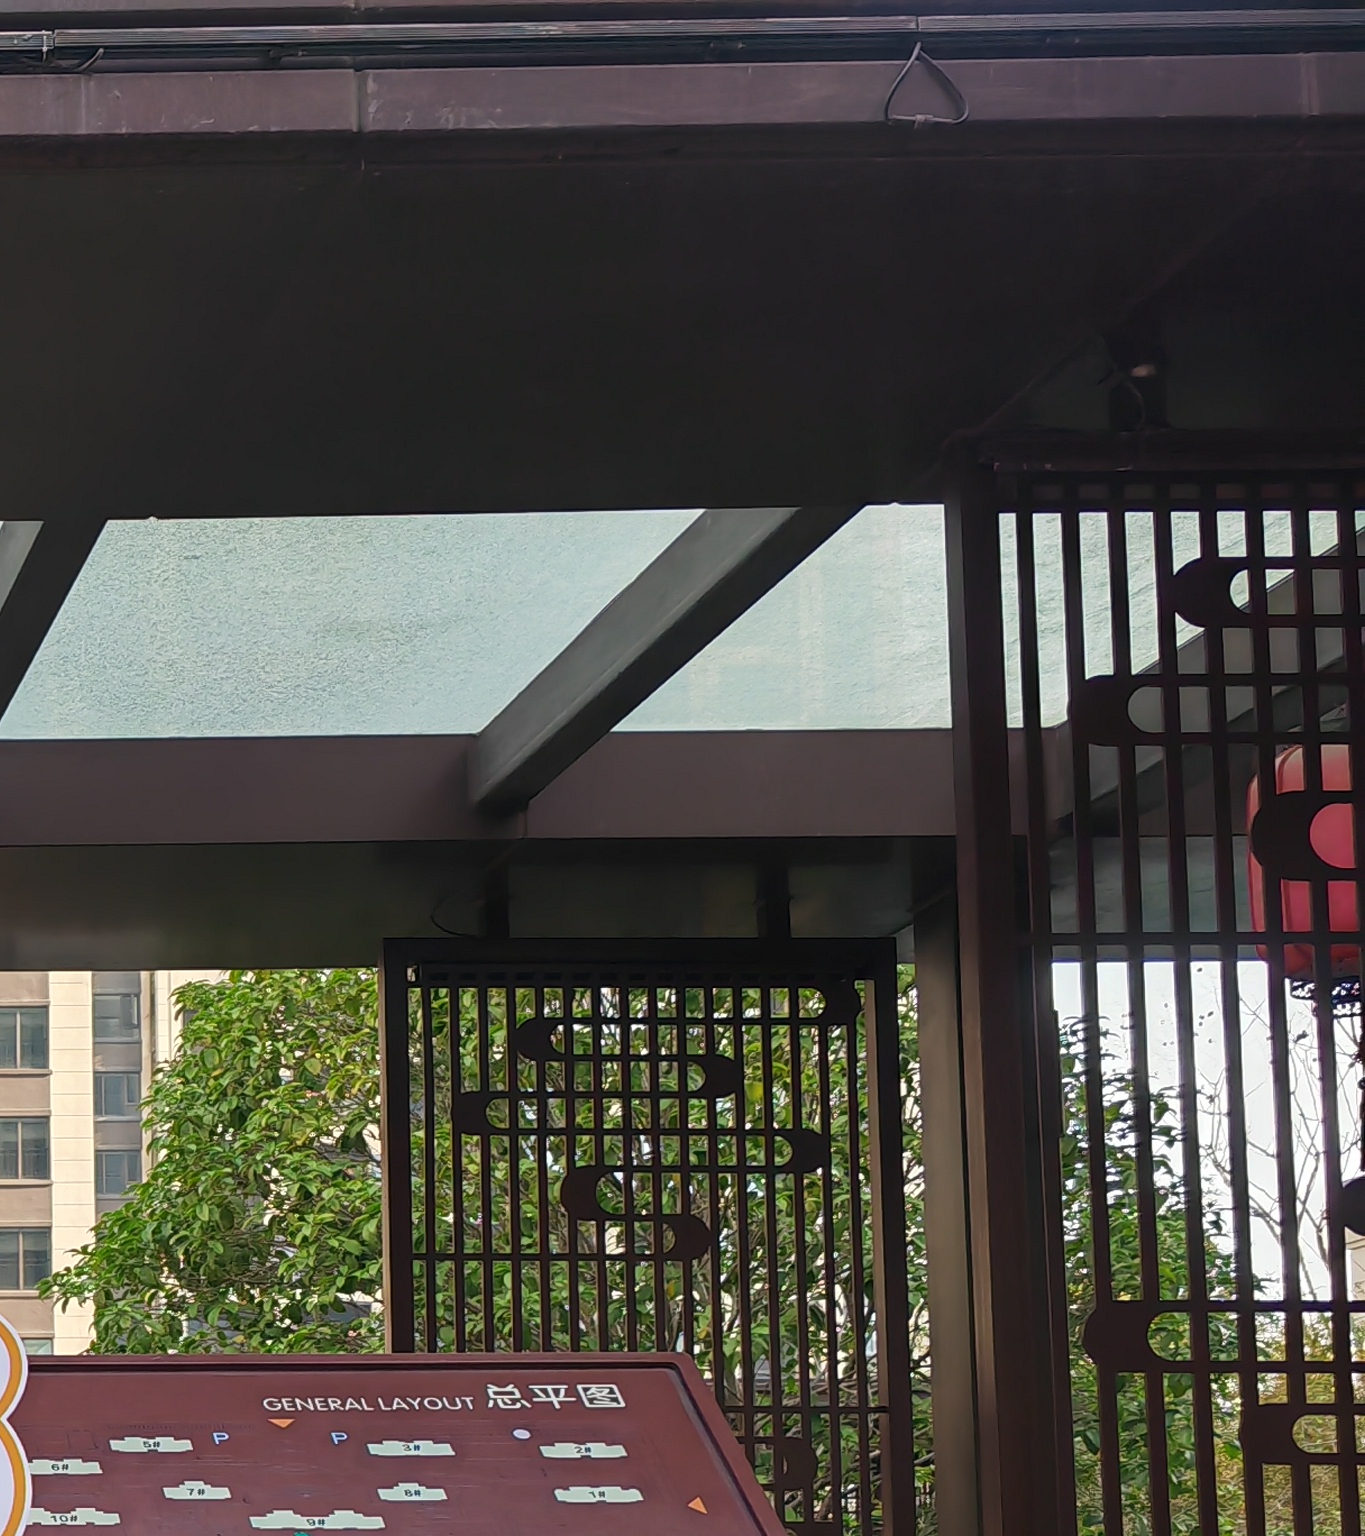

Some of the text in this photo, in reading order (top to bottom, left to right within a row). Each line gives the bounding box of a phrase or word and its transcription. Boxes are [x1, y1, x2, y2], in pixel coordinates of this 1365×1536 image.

[486, 1383, 626, 1410] 总平图
[263, 1396, 474, 1412] GENERAL LAYOUT
[213, 1432, 229, 1444] P
[331, 1432, 348, 1445] P
[402, 1444, 421, 1452] 3#
[574, 1446, 592, 1454] 2#
[51, 1463, 69, 1472] 6#
[186, 1488, 206, 1497] 7#
[50, 1514, 79, 1523] 10#
[306, 1518, 326, 1527] 9#
